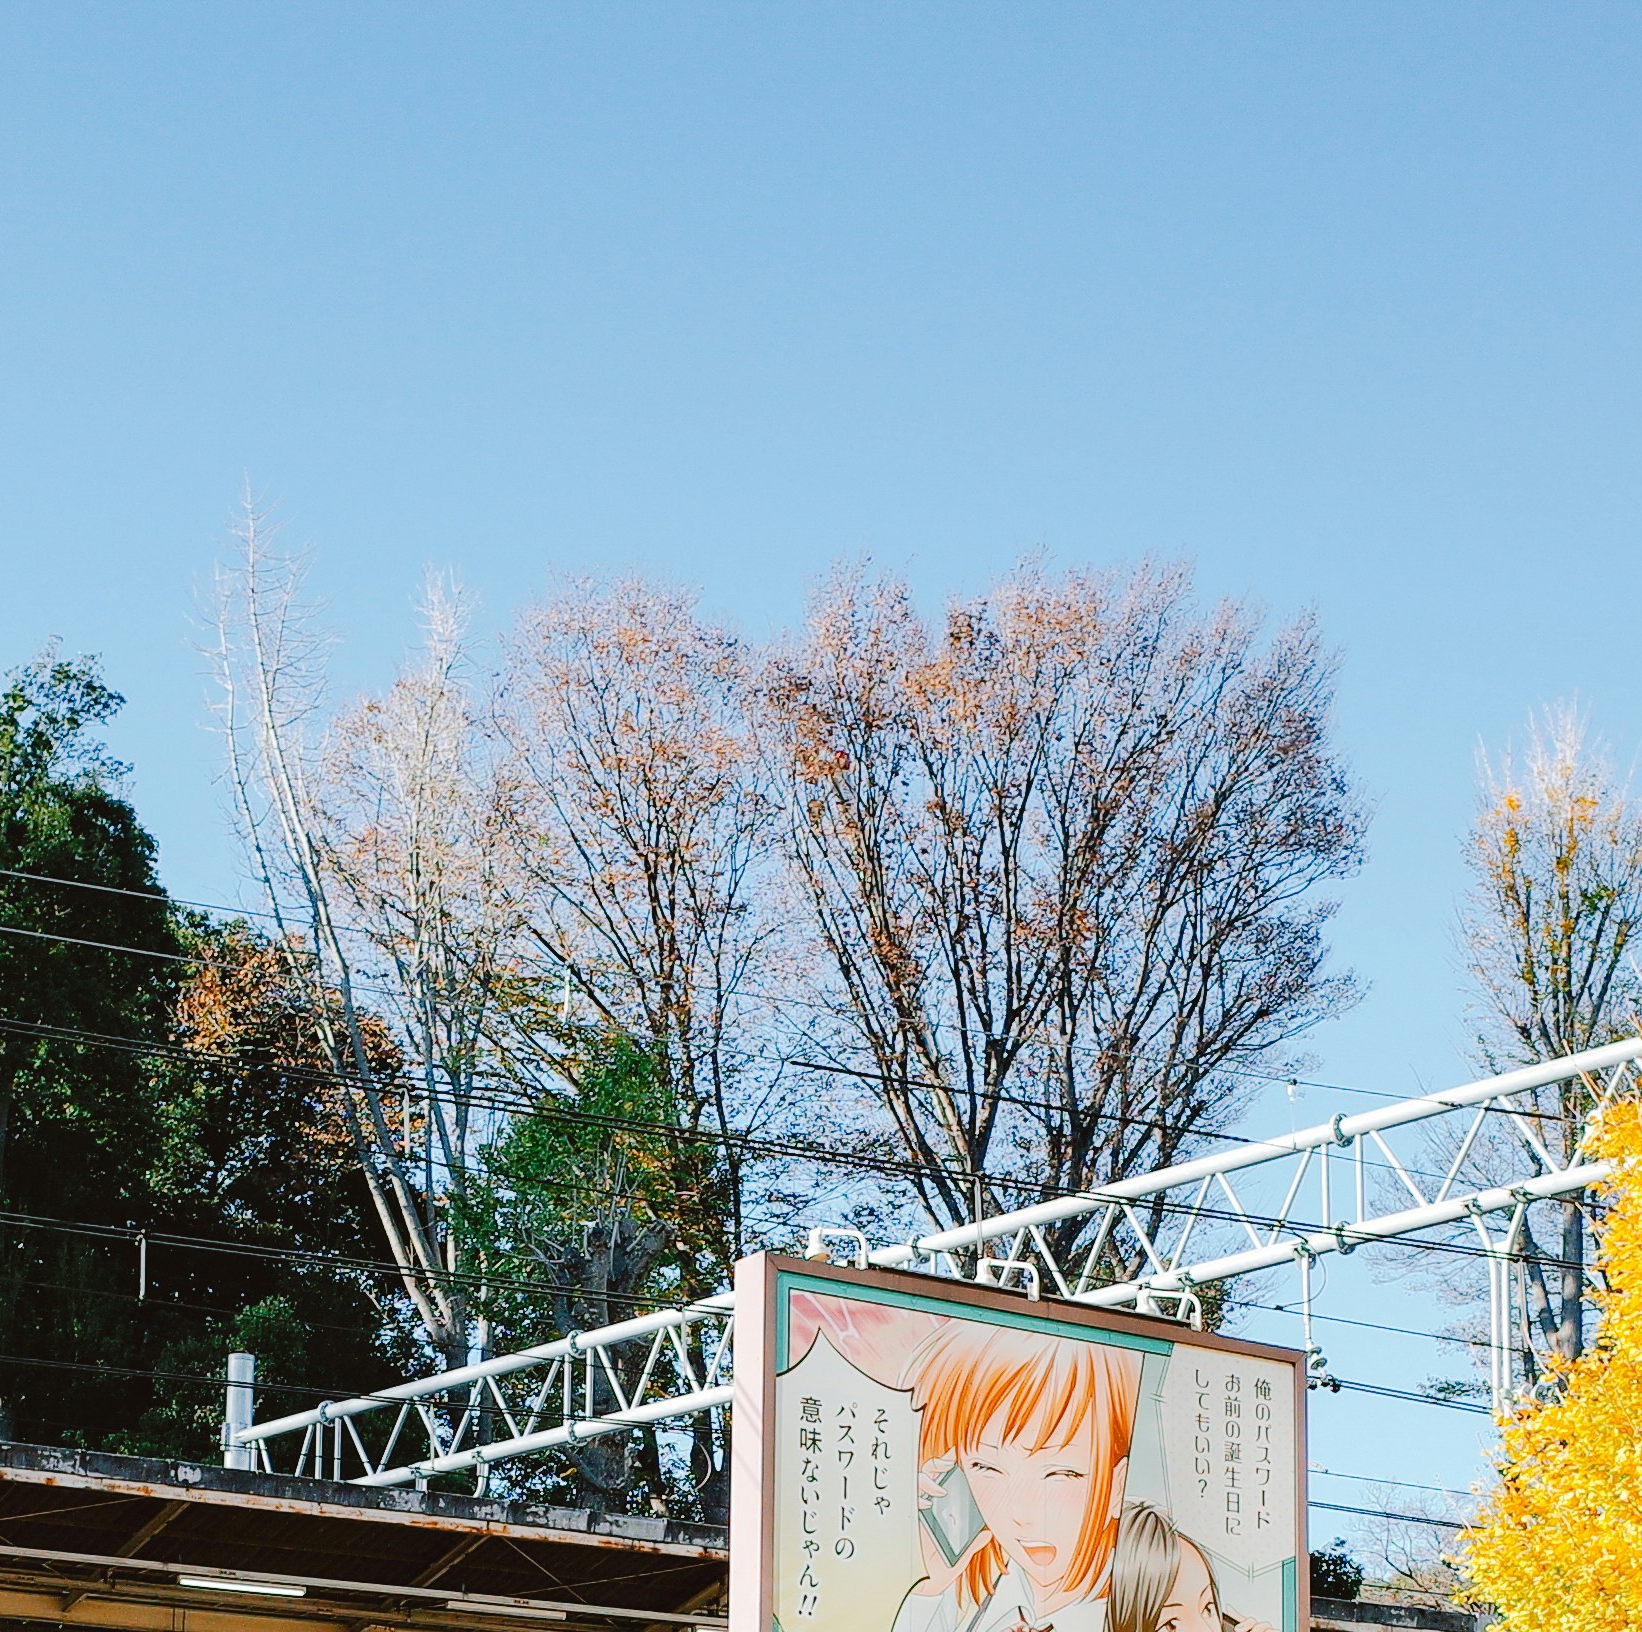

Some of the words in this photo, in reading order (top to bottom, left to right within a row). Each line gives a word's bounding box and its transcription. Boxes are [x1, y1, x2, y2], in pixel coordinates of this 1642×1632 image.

[835, 1401, 859, 1560] パスワードの
[870, 1408, 892, 1515] それじゃ
[1194, 1368, 1210, 1499] してもいい？
[1223, 1373, 1243, 1537] お前の誕生日に
[1254, 1377, 1272, 1530] 俺のパスワード
